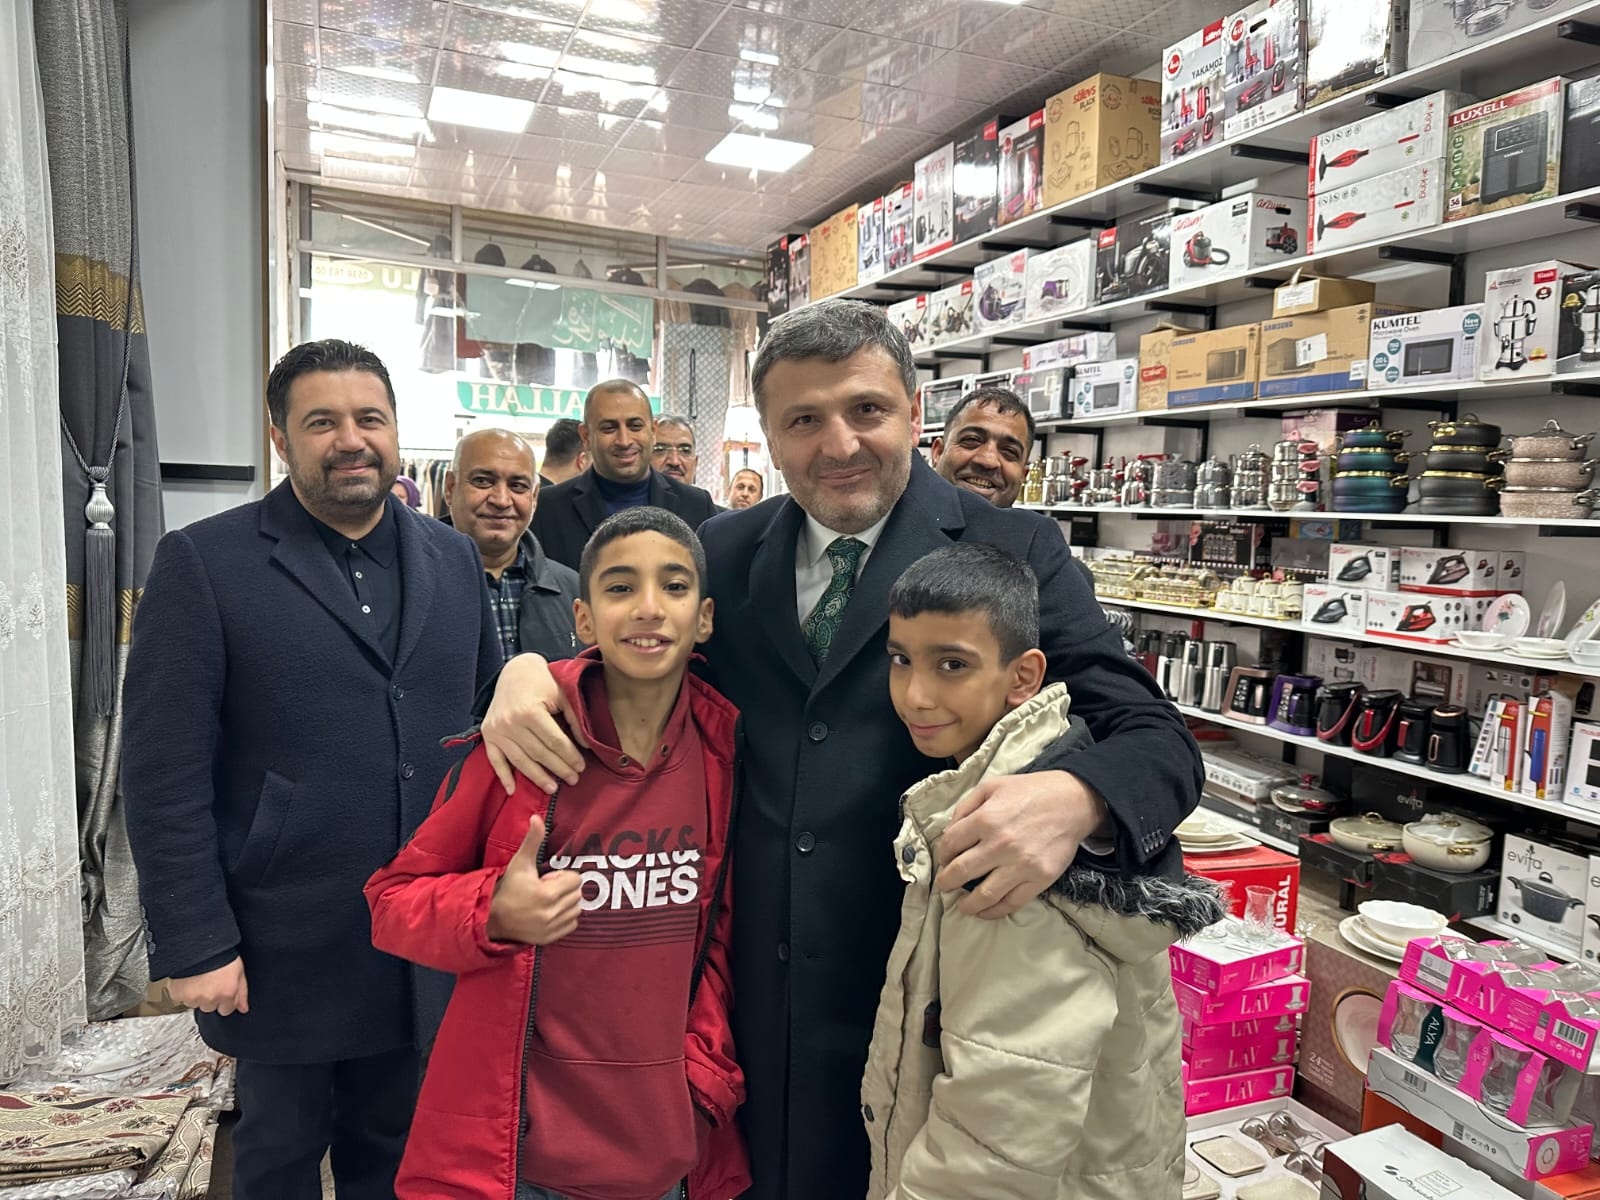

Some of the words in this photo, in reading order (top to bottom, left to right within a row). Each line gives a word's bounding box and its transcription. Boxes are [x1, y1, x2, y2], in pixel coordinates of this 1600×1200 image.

[1191, 56, 1223, 80] YAKAMOZ
[1079, 96, 1096, 110] BLACK
[1452, 100, 1509, 125] LUXELL
[1263, 320, 1294, 332] SAMSUNG
[1373, 315, 1421, 331] KUMTEL
[1404, 325, 1420, 333] Oven
[1507, 844, 1542, 873] evita
[580, 866, 699, 911] ONES
[1274, 874, 1292, 932] URAL
[1241, 991, 1275, 1015] LAV
[1454, 974, 1507, 1015] LAV
[1424, 1016, 1440, 1046] ALYA
[1228, 1046, 1260, 1069] LAV
[1309, 1051, 1322, 1067] 24
[1225, 1079, 1258, 1103] LAV
